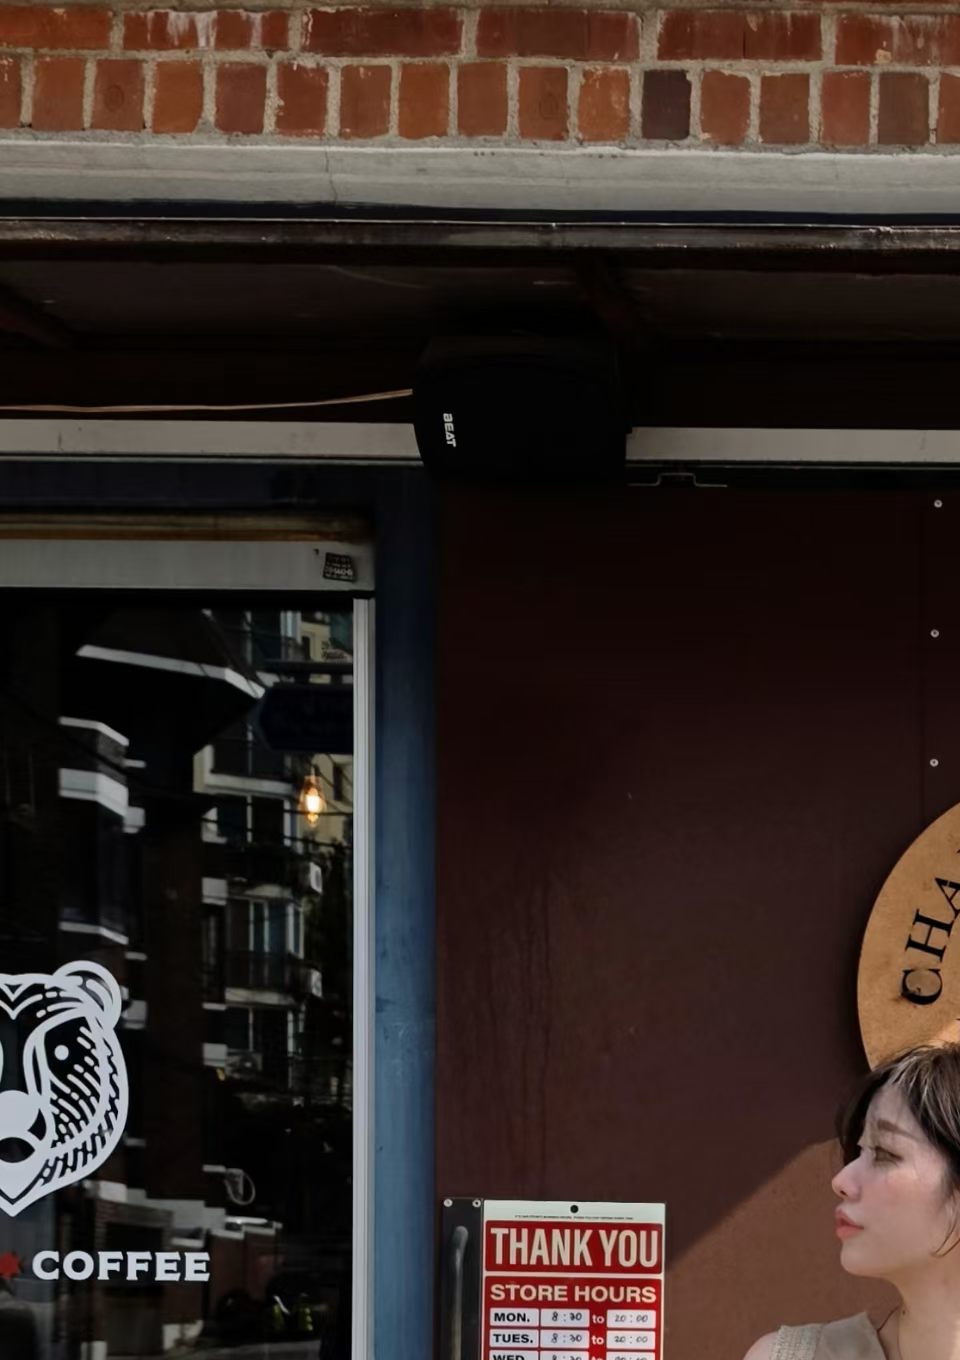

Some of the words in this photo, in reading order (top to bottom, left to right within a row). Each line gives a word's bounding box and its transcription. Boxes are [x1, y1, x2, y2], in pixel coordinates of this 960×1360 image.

[490, 1227, 593, 1266] THANK
[599, 1229, 658, 1268] YOU
[32, 1250, 210, 1282] COFFEE
[490, 1284, 568, 1301] STORE
[574, 1286, 657, 1302] HOURS
[493, 1312, 531, 1323] MON.
[592, 1314, 604, 1324] to
[493, 1334, 534, 1344] TUES.
[592, 1335, 604, 1345] to
